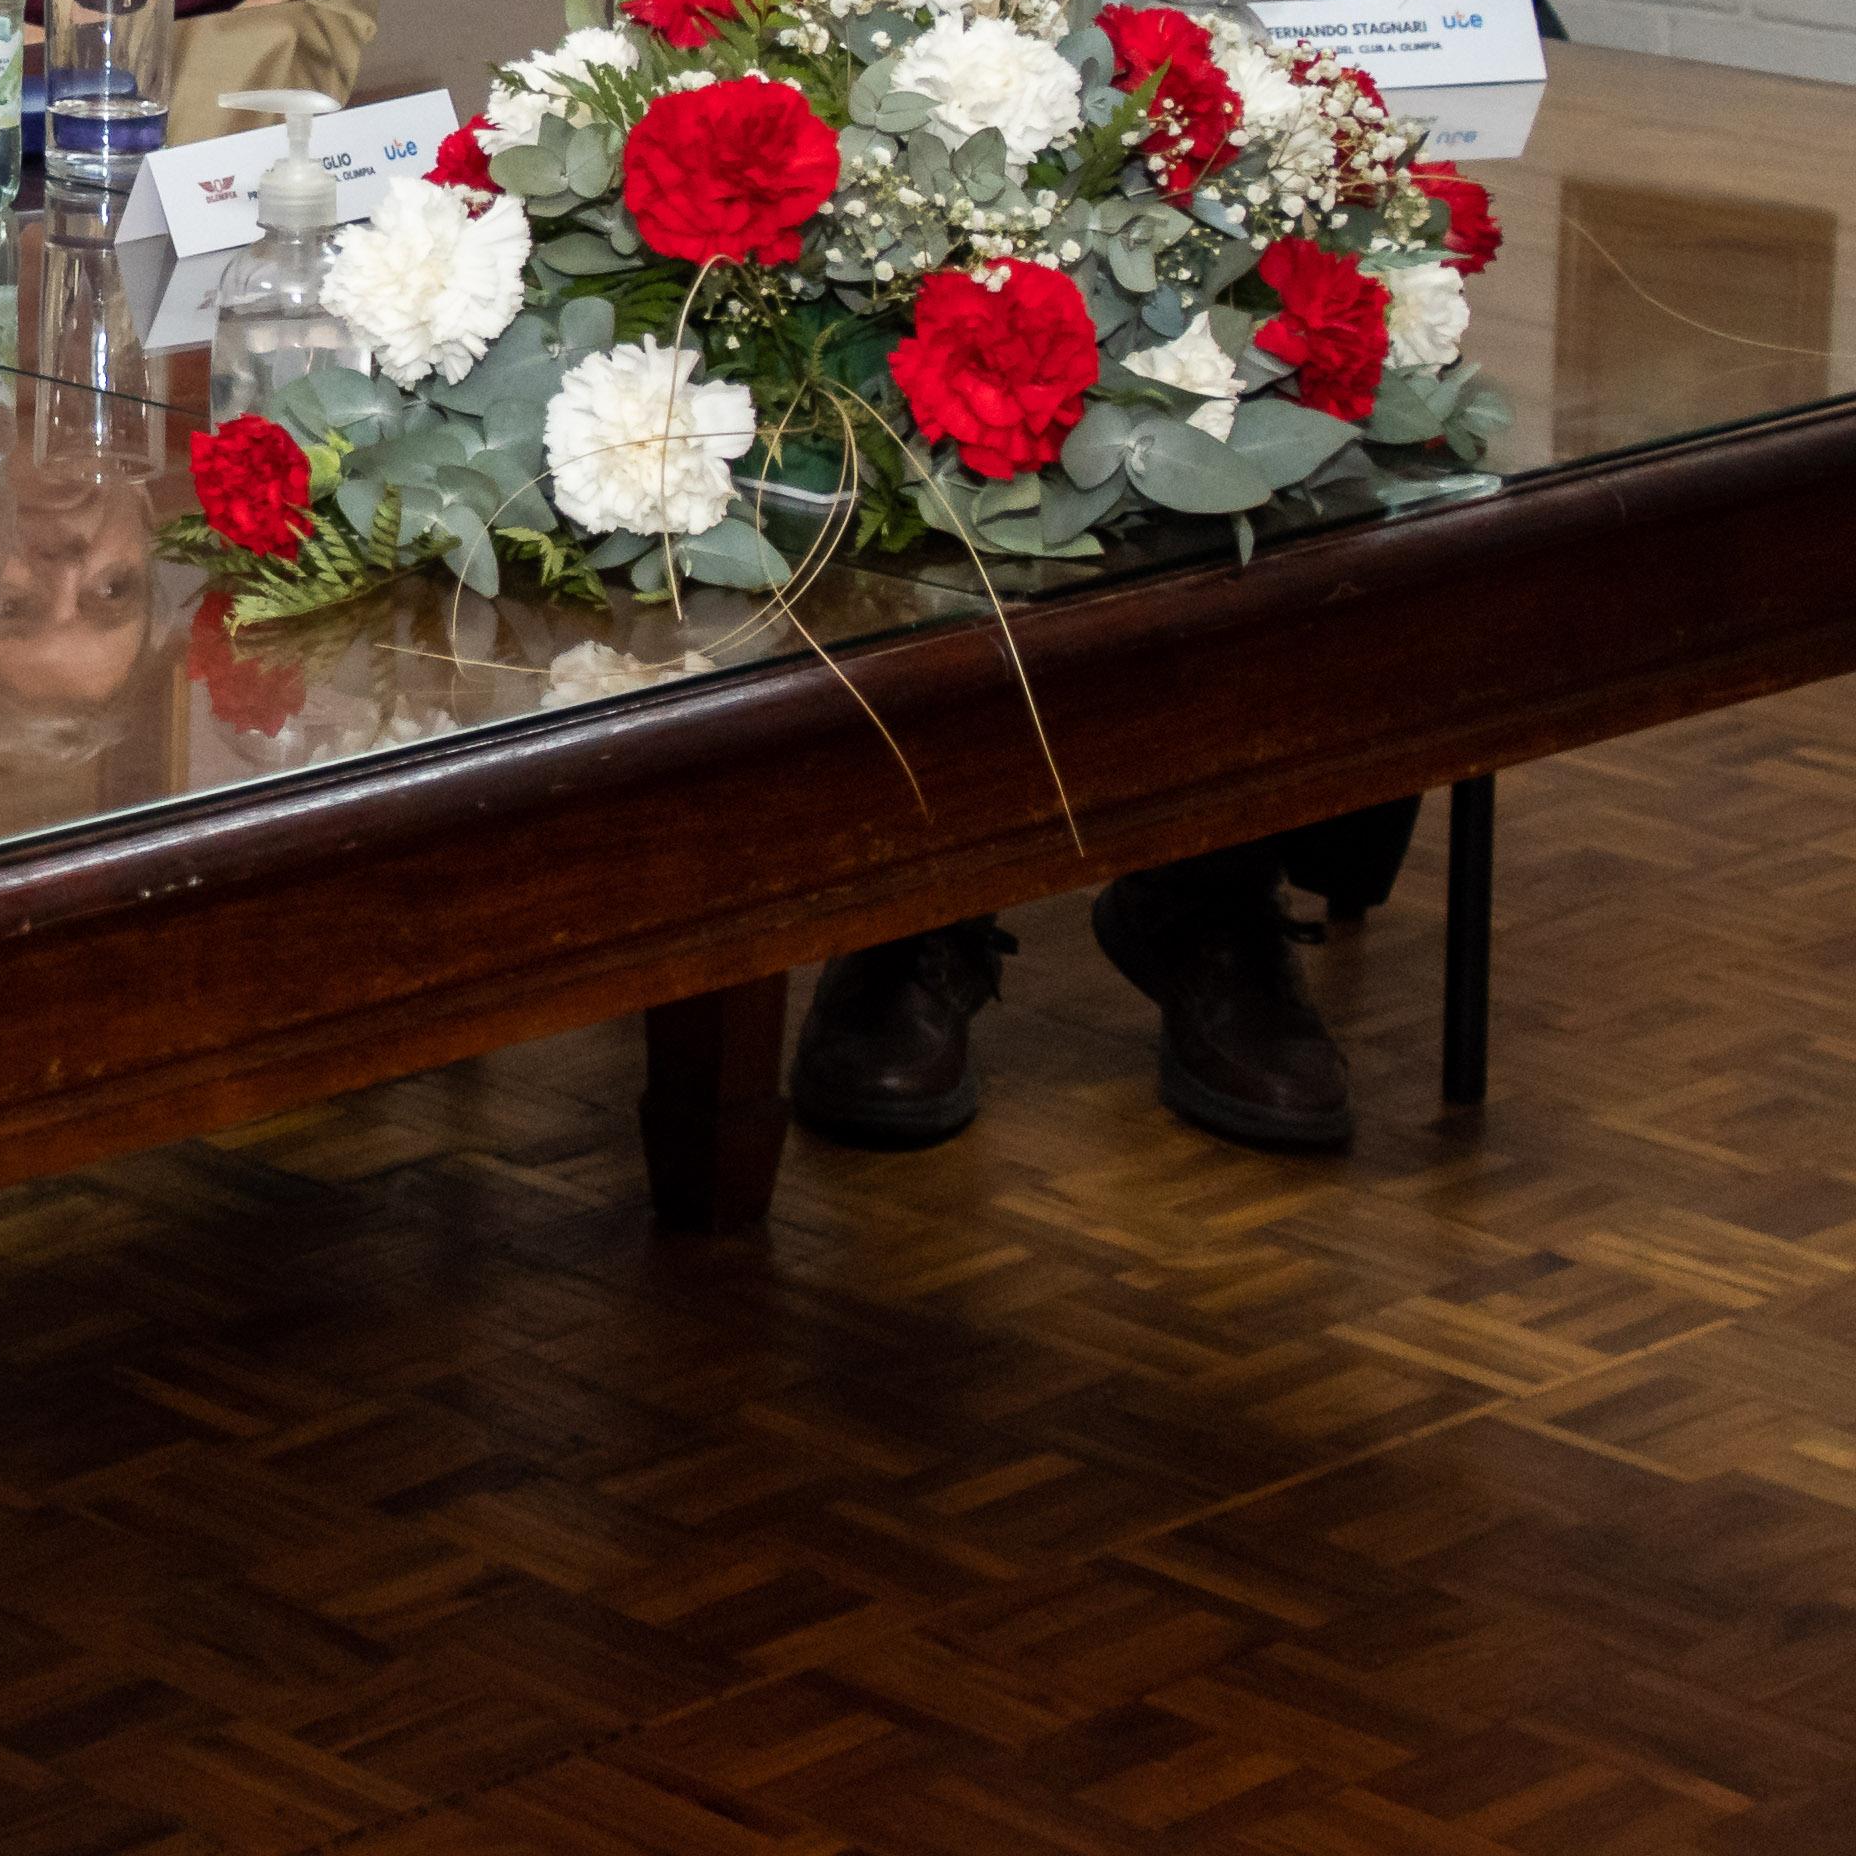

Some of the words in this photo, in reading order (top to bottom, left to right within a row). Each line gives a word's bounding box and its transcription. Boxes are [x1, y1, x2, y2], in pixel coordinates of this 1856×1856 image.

[1352, 20, 1427, 36] STAGNARI
[1442, 9, 1483, 31] ute
[1359, 44, 1384, 54] CLUB
[1400, 41, 1442, 52] OLIMPIA
[384, 138, 418, 161] ute
[342, 166, 376, 181] OLIMPIA
